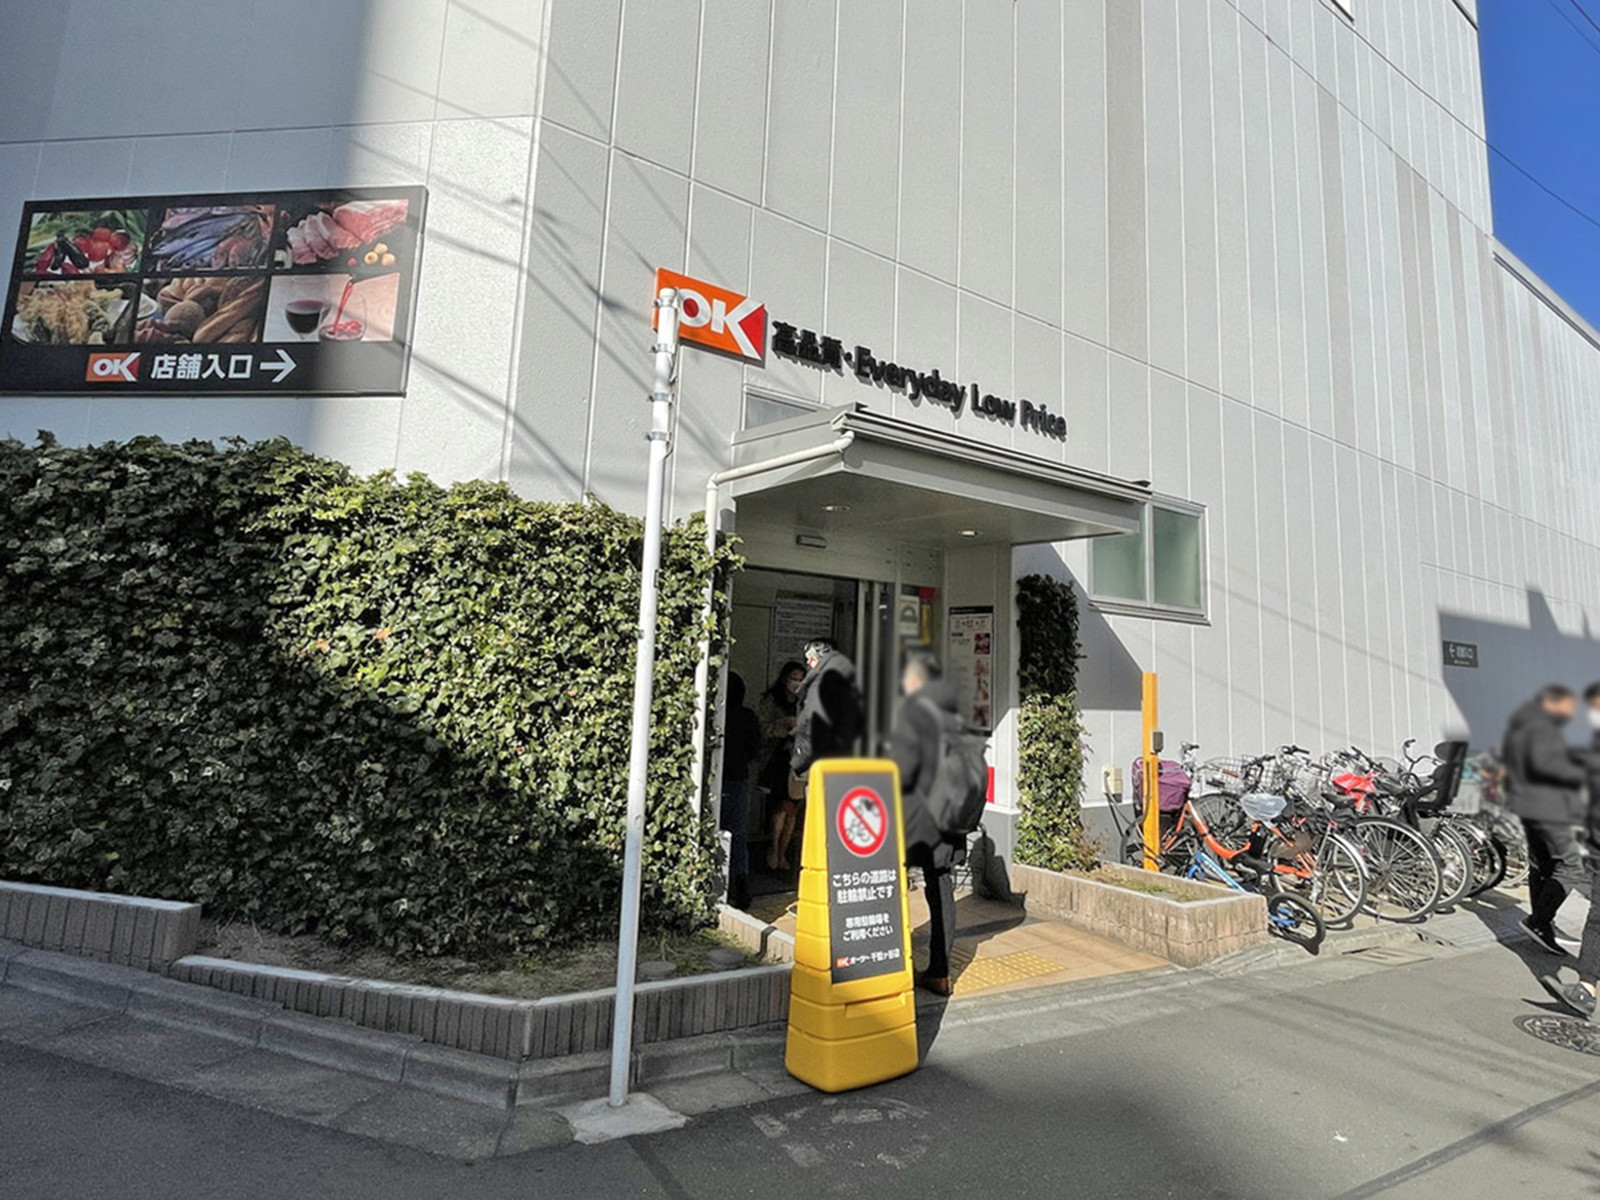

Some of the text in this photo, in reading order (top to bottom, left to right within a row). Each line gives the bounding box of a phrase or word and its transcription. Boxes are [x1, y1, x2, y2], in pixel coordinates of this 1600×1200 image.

[679, 287, 765, 361] OK
[92, 352, 253, 382] OK 店舗入口
[970, 383, 1016, 423] Low
[1020, 399, 1067, 439] Price
[832, 869, 897, 887] こちらの道路は
[837, 885, 894, 904] 駐輪禁止です
